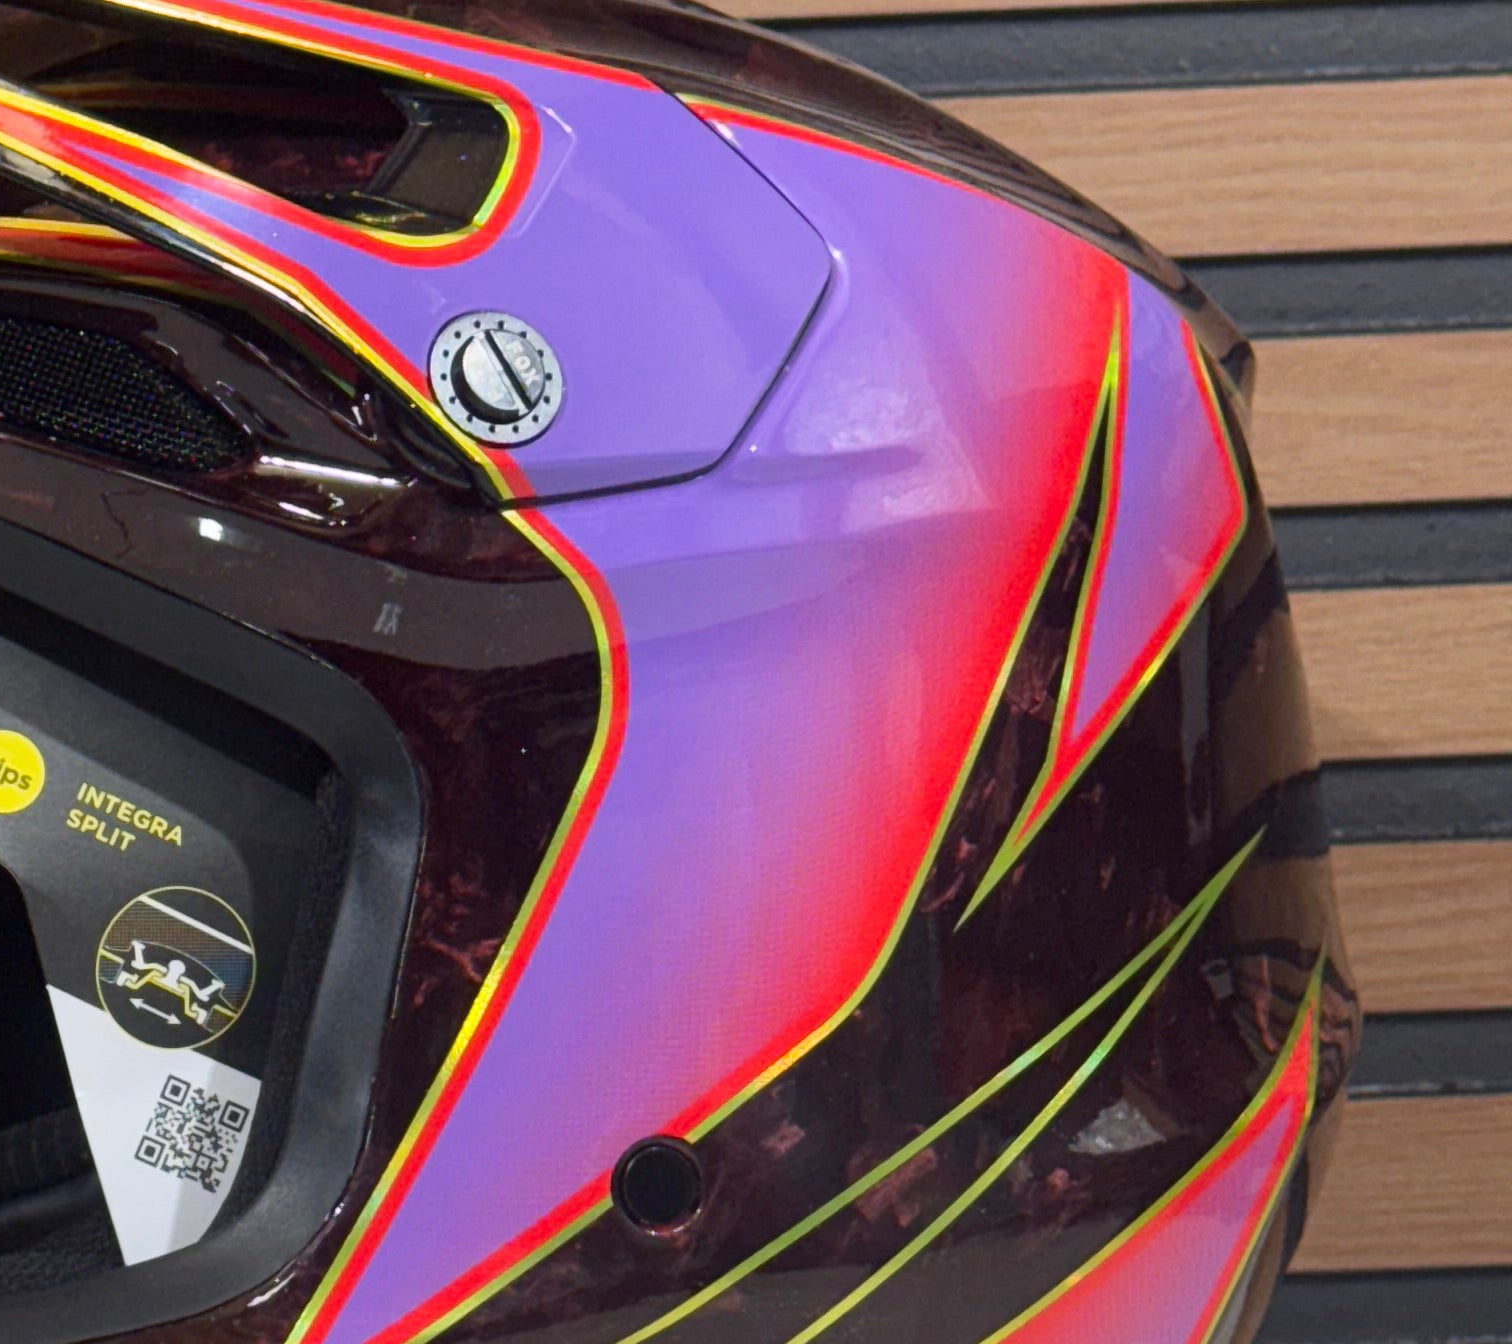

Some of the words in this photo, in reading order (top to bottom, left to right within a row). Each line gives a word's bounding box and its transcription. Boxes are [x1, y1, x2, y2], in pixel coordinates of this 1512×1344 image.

[506, 340, 540, 385] FOX
[65, 808, 137, 852] SPLIT
[76, 782, 184, 847] INTEGRA
